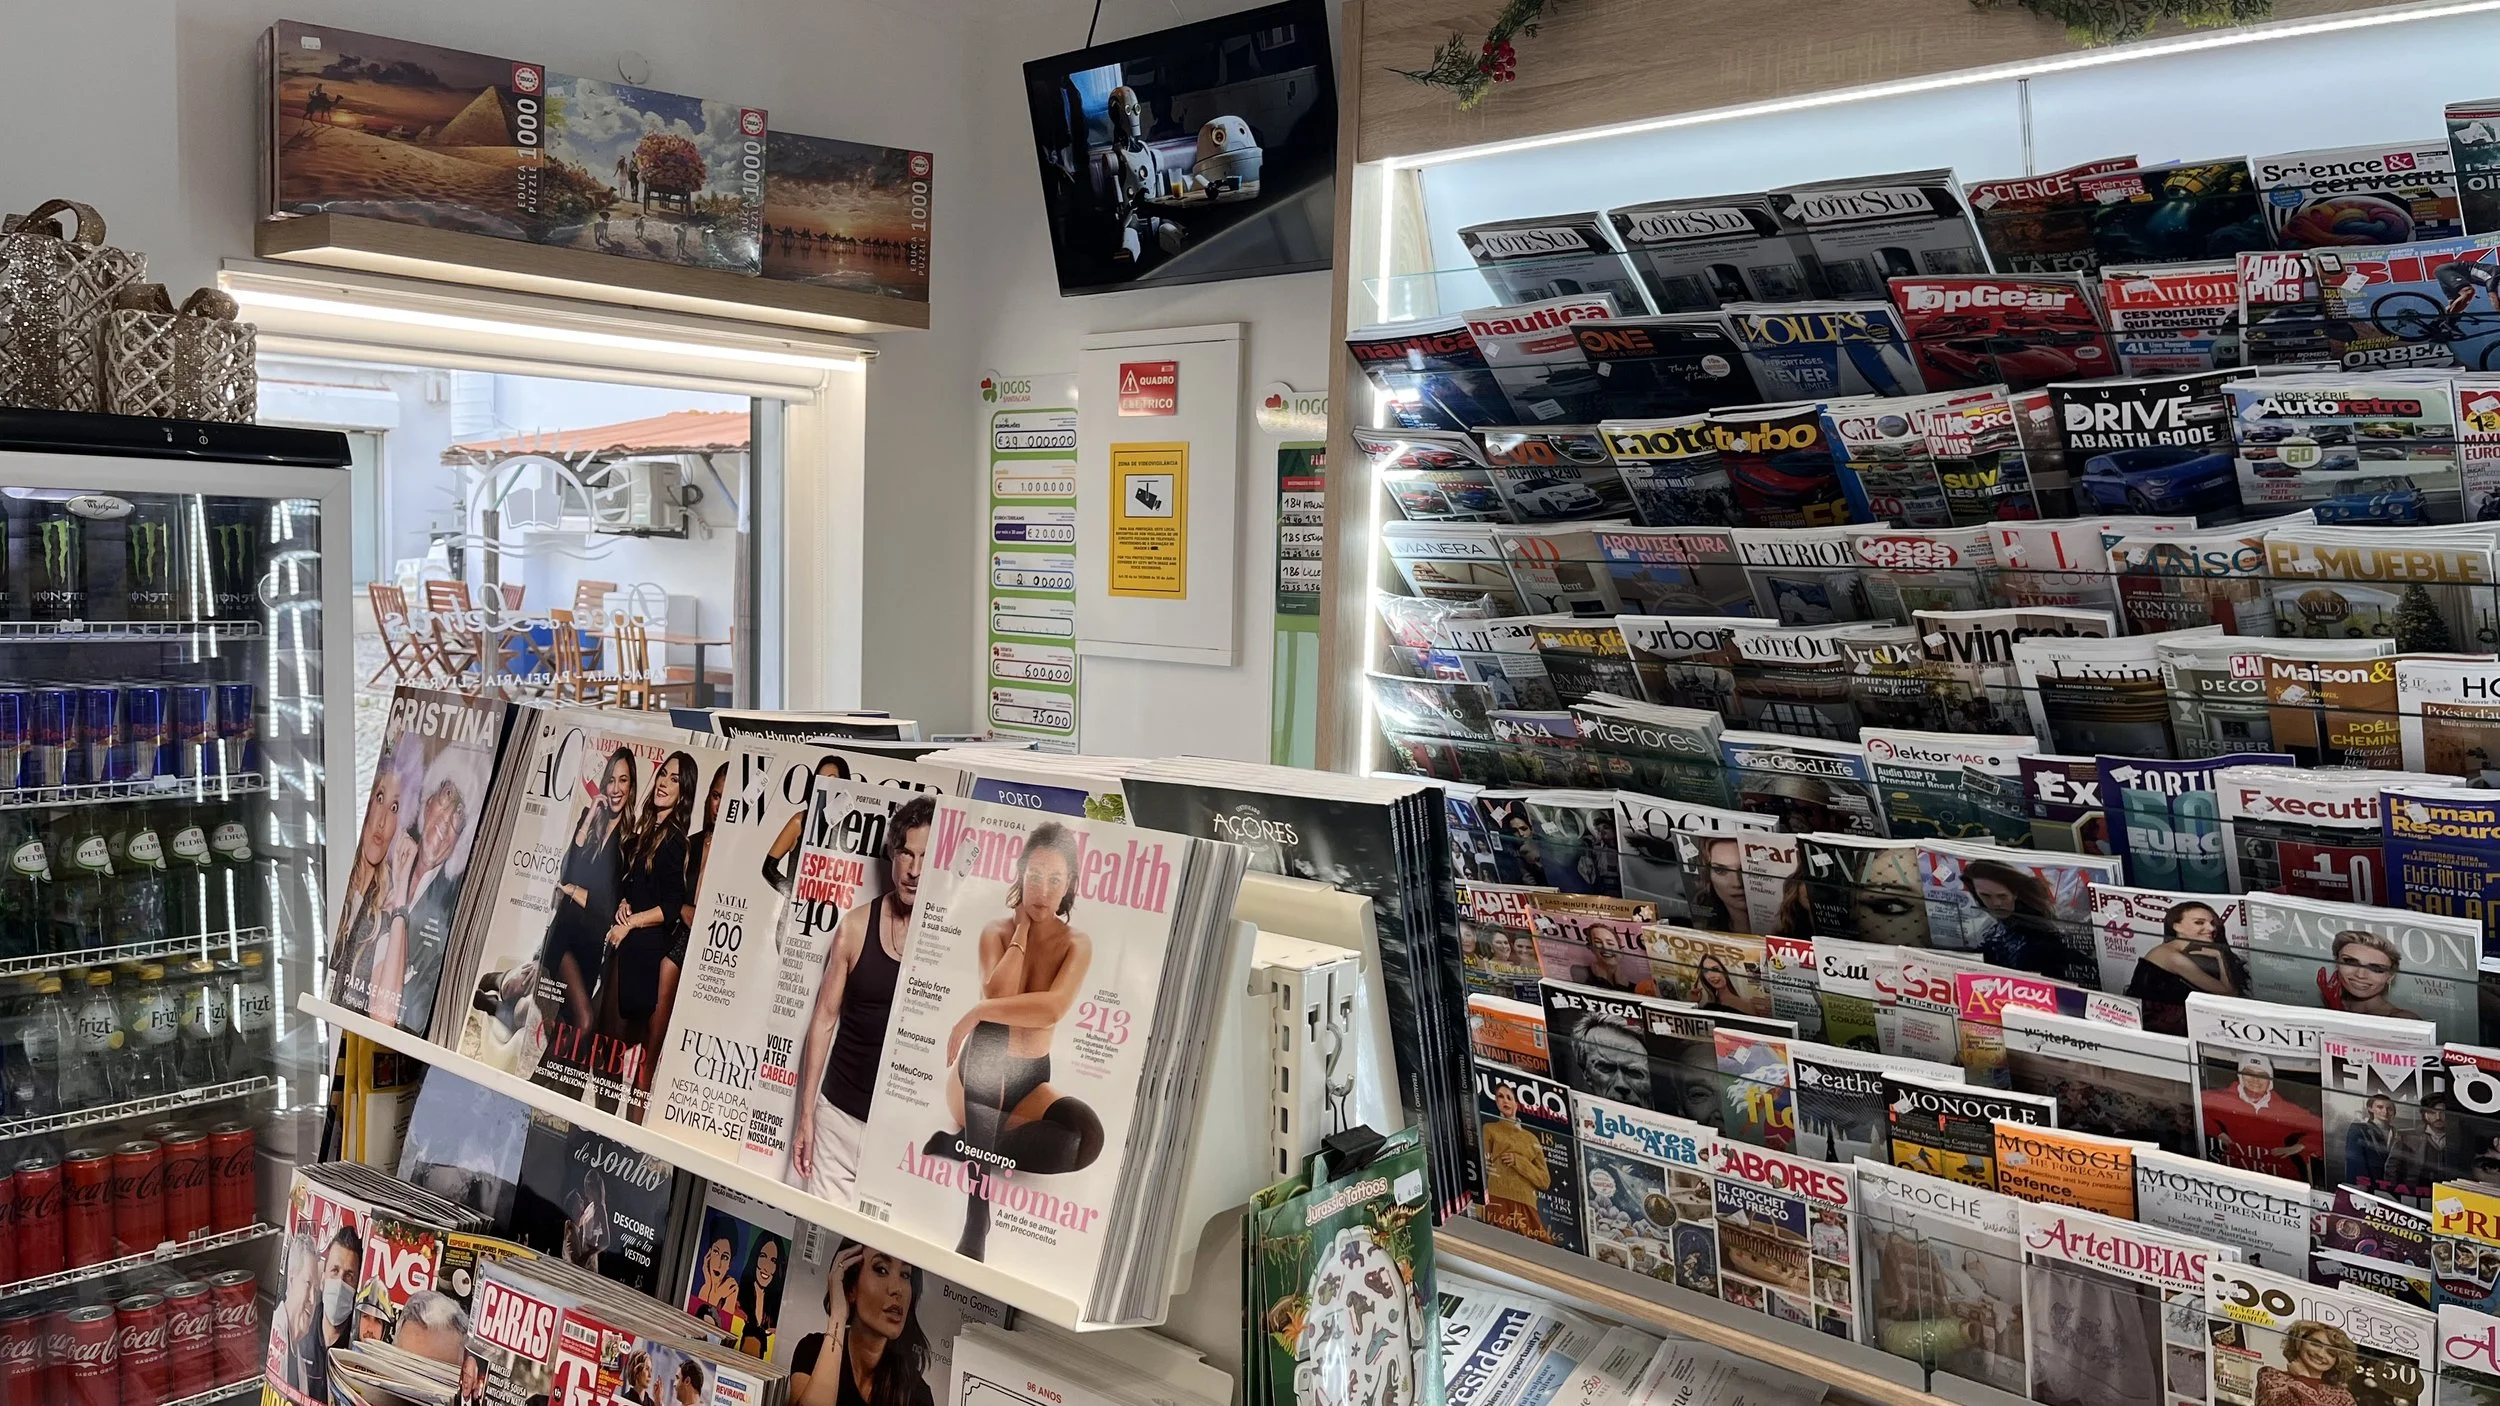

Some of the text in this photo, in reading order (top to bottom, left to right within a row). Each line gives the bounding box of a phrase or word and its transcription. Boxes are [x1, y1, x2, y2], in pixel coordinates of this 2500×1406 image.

[517, 98, 538, 160] 1000
[743, 141, 761, 196] 1000
[2389, 154, 2413, 171] &
[517, 165, 527, 208] EDUCA
[528, 166, 538, 213] PUZZLE
[2311, 169, 2447, 195] cerveau
[911, 181, 928, 232] 1000
[910, 236, 918, 271] EDUCA
[1901, 284, 2075, 313] TopGear
[2248, 281, 2300, 302] Plus
[1469, 304, 1610, 338] nautica
[2121, 307, 2227, 320] CES VOITURES
[2124, 317, 2219, 330] QUI PENSENT
[1352, 331, 1478, 361] nautica
[1582, 329, 1654, 353] ONE
[2343, 344, 2455, 369] ORBEA
[1000, 379, 1032, 395] JOGOS
[1139, 374, 1175, 386] QUADRO
[2261, 398, 2422, 418] Autoretro
[1714, 422, 1817, 455] turbo
[2070, 428, 2151, 449] ABARTH
[1508, 466, 1546, 480] ALPINE
[1943, 468, 1998, 490] SUV
[86, 500, 120, 512] Whirlpool
[1394, 541, 1488, 556] MANERA
[1514, 537, 1562, 570] AD
[1602, 533, 1730, 553] ARQUITECTURA
[2272, 661, 2396, 685] Maison &
[587, 735, 629, 753] SABER
[1770, 756, 1854, 778] Good Life
[1952, 752, 1984, 766] MAG
[1878, 766, 1938, 782] Audio DSP FX
[855, 794, 882, 806] PORTUGAL
[998, 789, 1043, 809] PORTO
[980, 815, 1028, 832] PORTUGAL
[1211, 812, 1299, 846] AÇORES
[1850, 814, 1875, 832] 25
[534, 842, 552, 856] ZONA
[801, 852, 864, 887] ESPECIAL
[715, 892, 748, 910] NATAL
[797, 876, 856, 910] HOMENS
[2404, 883, 2481, 899] FICAM NA
[713, 908, 744, 923] MAIS DE
[923, 911, 945, 923] boost
[1494, 913, 1530, 928] Blick
[708, 920, 743, 950] 100
[940, 923, 962, 936] saúde
[700, 948, 737, 968] IDEIAS
[707, 965, 736, 979] PRESENTES
[908, 976, 951, 994] Cabelo forte
[910, 987, 943, 1003] brilhante
[1098, 988, 1119, 999] ESTUDO
[2413, 976, 2457, 992] WALLIS
[2423, 985, 2446, 998] DAY
[702, 993, 730, 1007] ADVENTO
[1093, 994, 1121, 1007] EXCLUSIVO
[1075, 1000, 1132, 1047] 213
[767, 1033, 793, 1053] VOLTE
[897, 1026, 937, 1046] Menopausa
[1072, 1036, 1120, 1054] portuguesas falam
[680, 1028, 760, 1069] FUNNY
[2324, 1041, 2348, 1058] THE
[2445, 1050, 2477, 1065] MOJO
[890, 1060, 934, 1082] #oMeuCorpo
[1509, 1050, 1549, 1073] TESSON
[760, 1063, 798, 1087] CABELO!
[671, 1077, 749, 1108] NESTA QUADRA,
[668, 1092, 748, 1123] ACIMA DE TUDO
[752, 1108, 783, 1128] VOCÊ PODE
[1897, 1088, 2037, 1127] MONOCLE
[664, 1103, 744, 1142] DIVIRTA-SE!
[1591, 1106, 1697, 1151] Labores
[747, 1130, 786, 1151] NOSSA CAPA!
[1539, 1131, 1555, 1148] 18
[1641, 1133, 1698, 1166] Ana
[964, 1144, 1017, 1170] seu corpo
[574, 1143, 667, 1194] de sonho
[2051, 1162, 2125, 1181] FORECAST
[896, 1140, 1100, 1235] Ana Guiomar
[2000, 1169, 2077, 1199] Defence.
[2141, 1165, 2302, 1220] MONOCLE
[1304, 1177, 1388, 1226] Jurassic Tattoos
[1717, 1181, 1787, 1211] EL CROCHET
[1885, 1179, 1982, 1219] CROCHÉ
[1743, 1200, 1790, 1222] FRESCO
[2173, 1191, 2301, 1229] ENTREPRENEURS
[613, 1211, 655, 1241] DESCOBRE
[1009, 1222, 1058, 1247] preconceitos
[2218, 1225, 2245, 1239] Austria
[449, 1238, 472, 1249] ESPECIAL
[369, 1237, 431, 1297] TVG
[624, 1248, 651, 1268] VESTIDO
[2078, 1255, 2094, 1265] UM
[2097, 1261, 2135, 1277] MUNDO
[2139, 1273, 2154, 1282] EM
[942, 1284, 1000, 1320] Bruno Gomes
[2444, 1283, 2483, 1299] OFERTA
[2223, 1303, 2268, 1317] NOUVELLE
[476, 1283, 555, 1361] CARAS
[2301, 1298, 2420, 1351] IDÉES
[1506, 1330, 1544, 1380] opportunity?
[490, 1362, 511, 1379] MARCELO
[2382, 1360, 2417, 1386] 50
[488, 1373, 528, 1398] REBELO SOUSA
[1026, 1381, 1063, 1404] 96 ANOS
